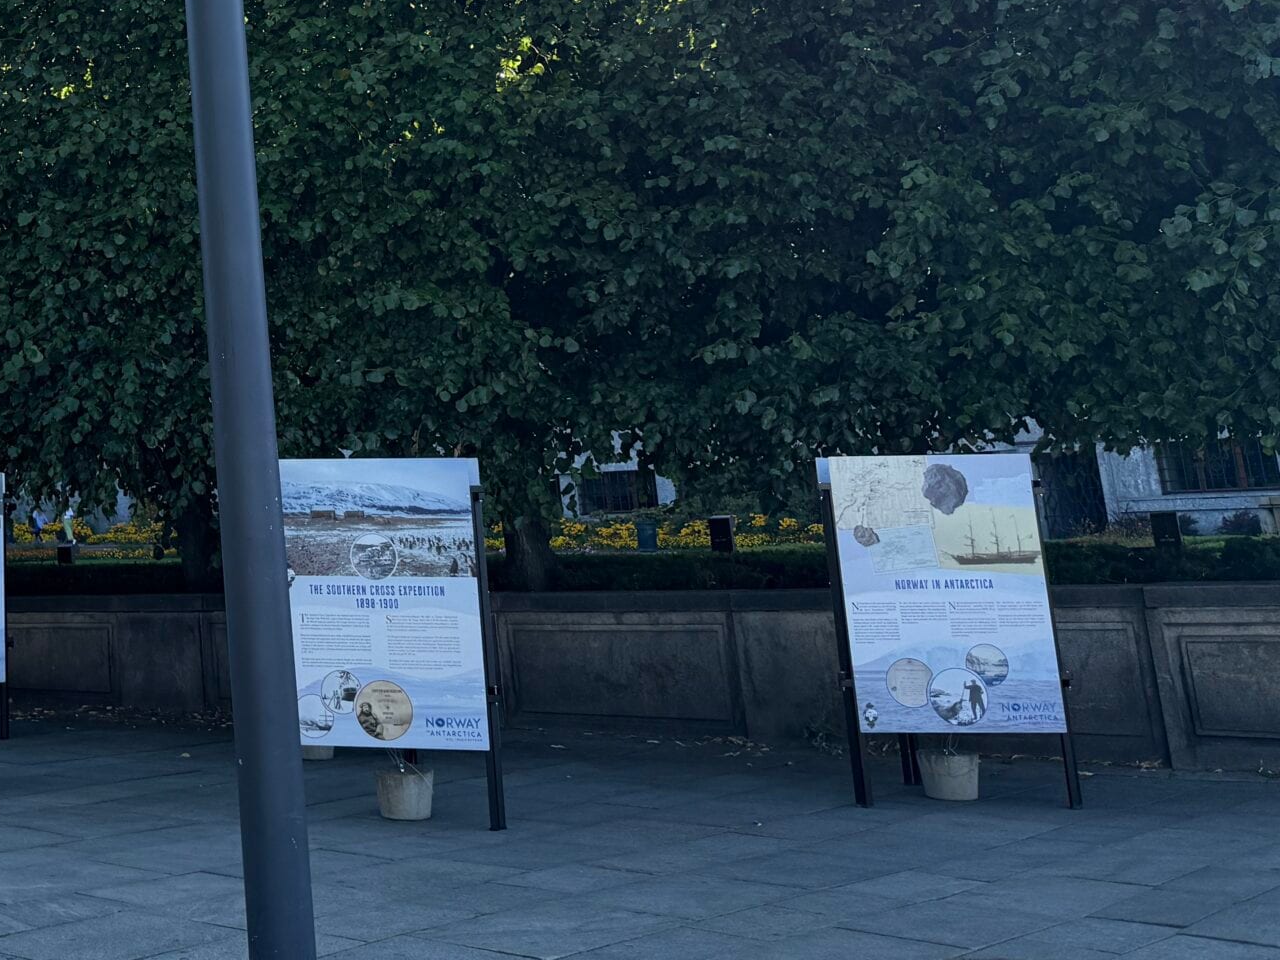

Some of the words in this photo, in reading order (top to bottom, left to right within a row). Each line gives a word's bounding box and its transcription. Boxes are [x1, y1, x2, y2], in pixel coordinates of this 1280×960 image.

[895, 579, 928, 590] NORWAY
[932, 579, 941, 590] IN
[944, 578, 994, 590] ANTARCTICA
[309, 584, 323, 595] THE
[326, 584, 367, 596] SOUTHERN
[370, 585, 396, 596] CROSS
[398, 585, 446, 597] EXPEDITION
[1001, 702, 1057, 713] NORWAY
[425, 716, 481, 730] NORWAY
[430, 729, 482, 738] ANTARCTICA
